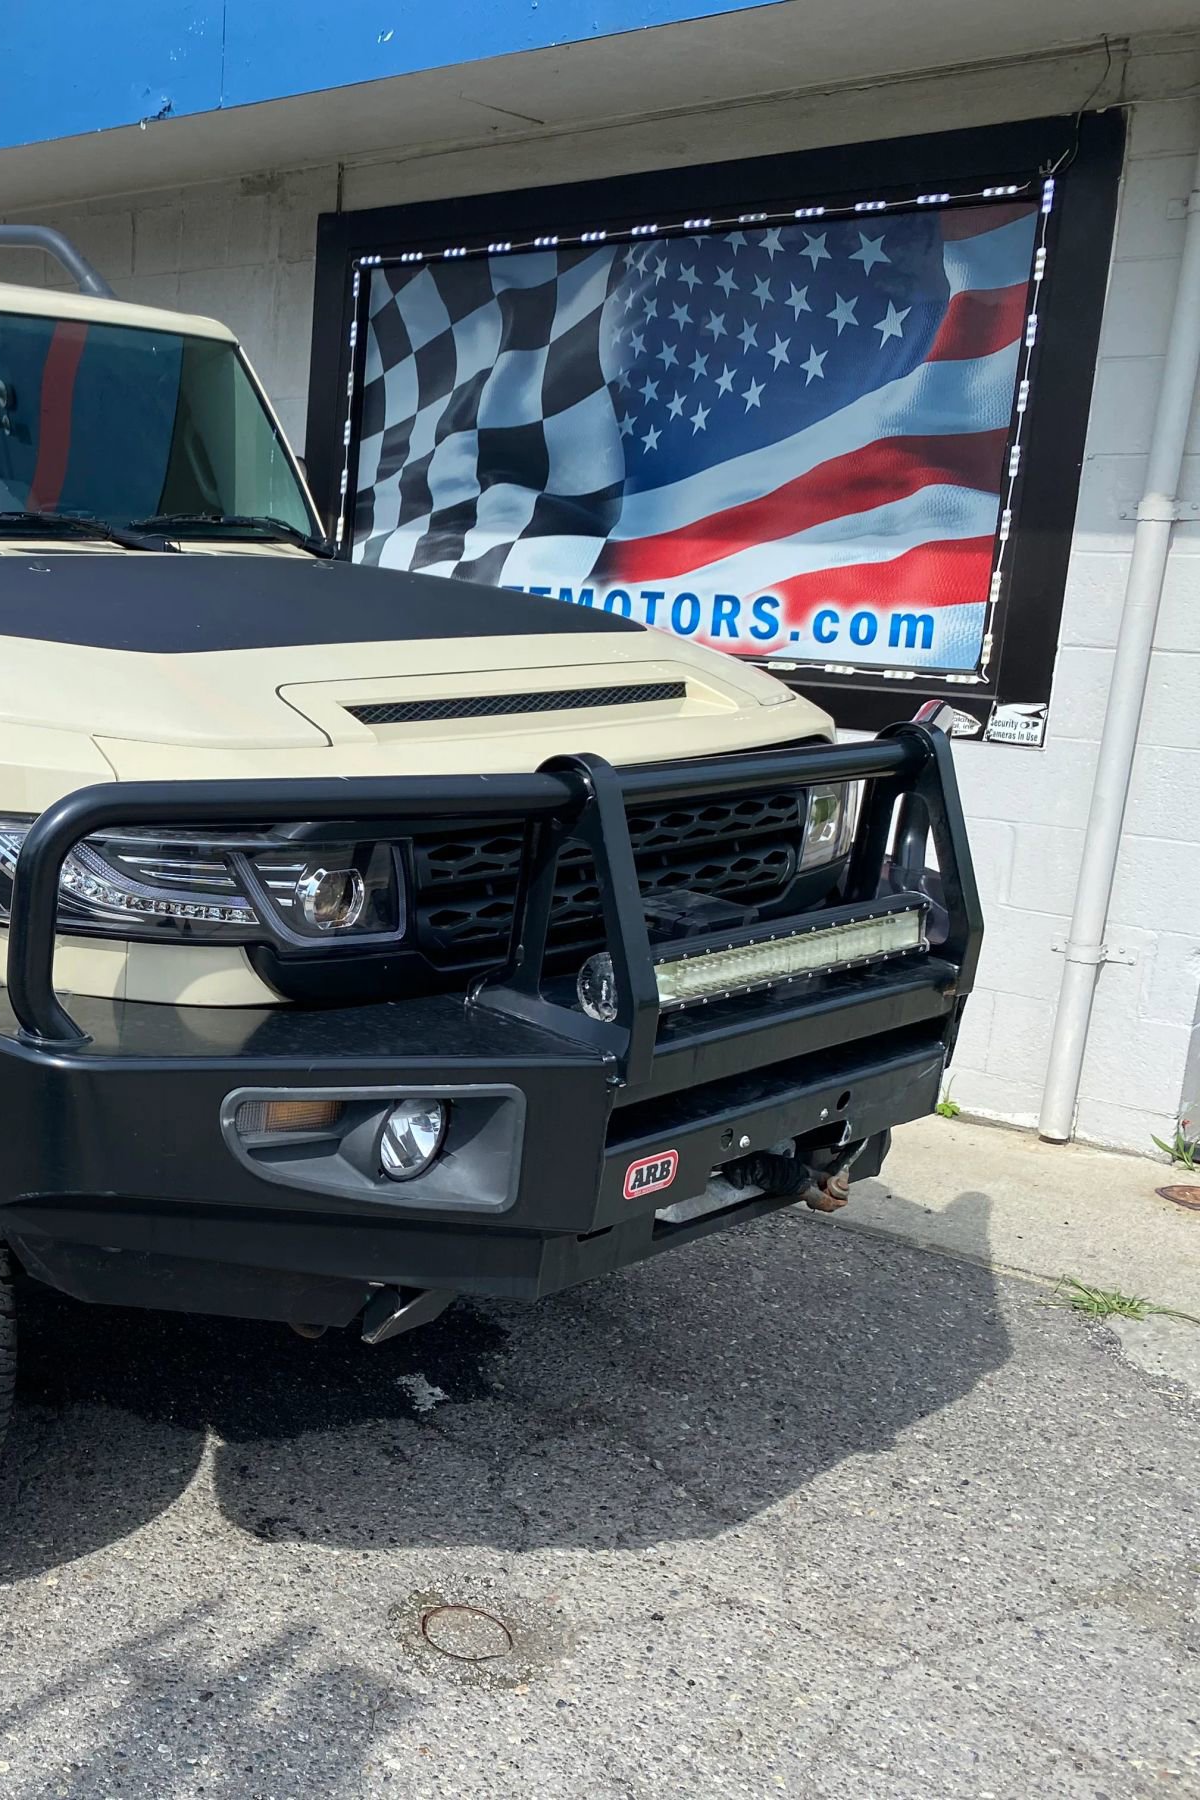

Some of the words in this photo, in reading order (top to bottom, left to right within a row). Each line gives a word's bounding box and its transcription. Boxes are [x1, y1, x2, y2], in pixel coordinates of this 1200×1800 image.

[502, 586, 934, 649] OTORS.com
[989, 728, 1016, 739] Cameras
[1018, 731, 1025, 741] In
[1026, 733, 1038, 742] Use
[990, 718, 1019, 730] Security
[630, 1159, 672, 1191] ARB
